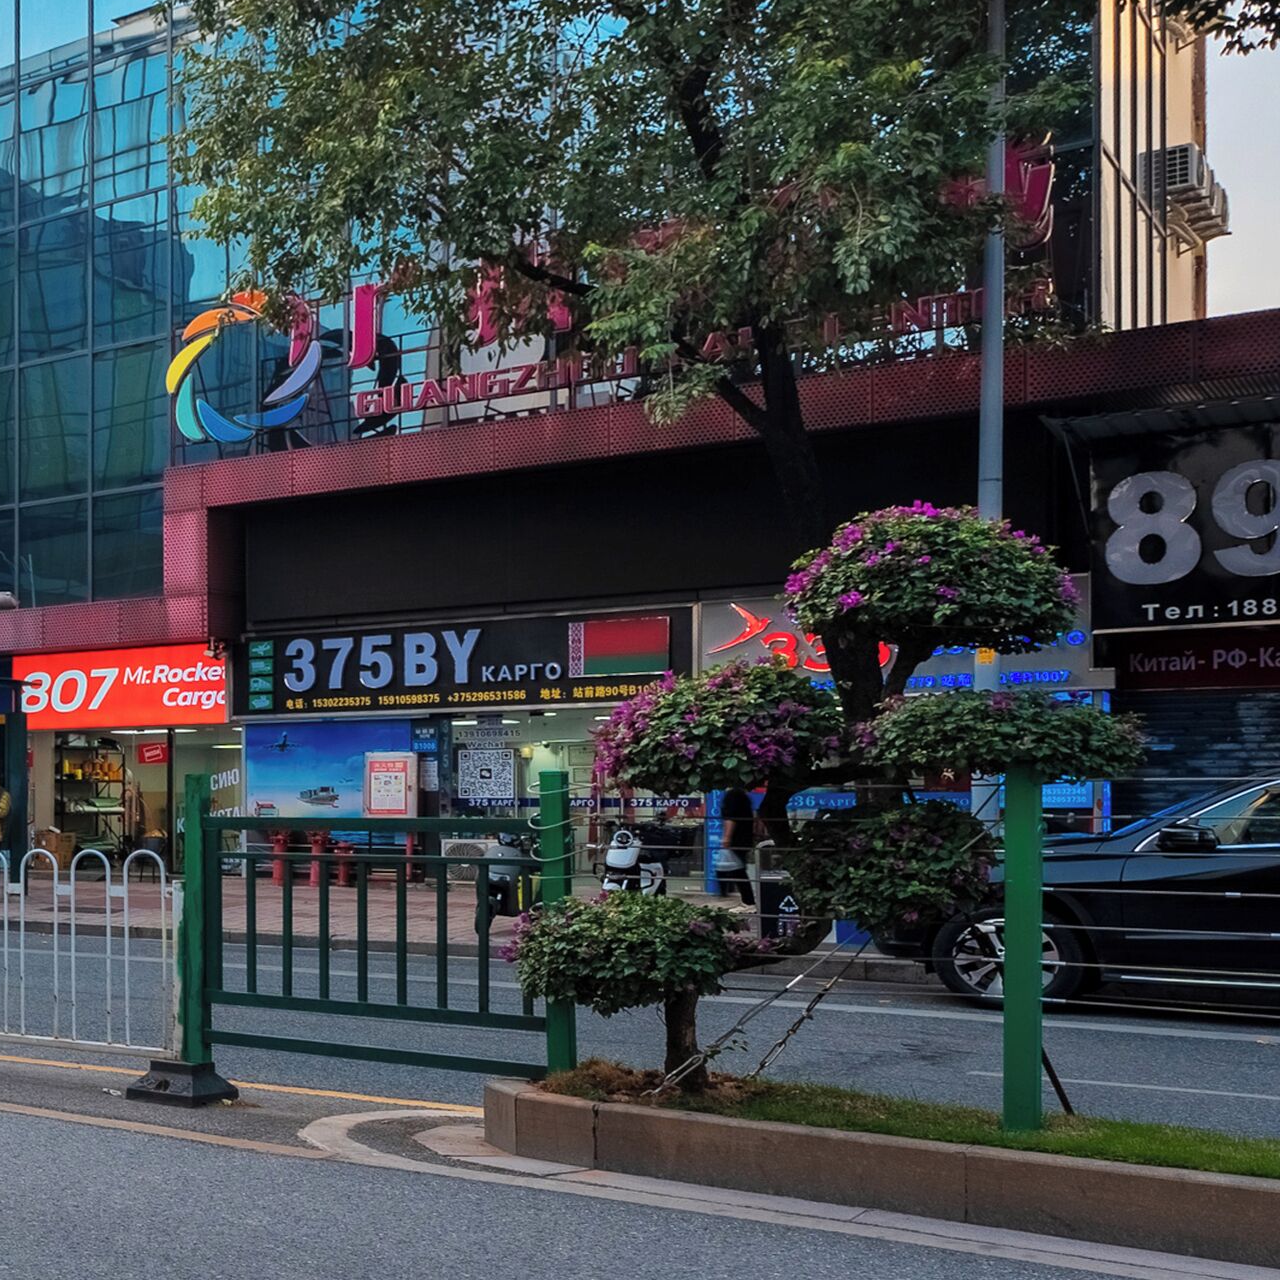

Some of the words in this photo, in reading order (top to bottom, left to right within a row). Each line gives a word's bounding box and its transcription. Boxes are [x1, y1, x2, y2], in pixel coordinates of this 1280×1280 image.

[355, 345, 638, 418] GUANGZHU
[481, 661, 562, 683] КАРГО
[21, 667, 120, 713] 807
[468, 799, 489, 807] 375
[569, 799, 595, 808] АРГО
[630, 797, 653, 808] 375
[656, 798, 690, 808] КАРГО
